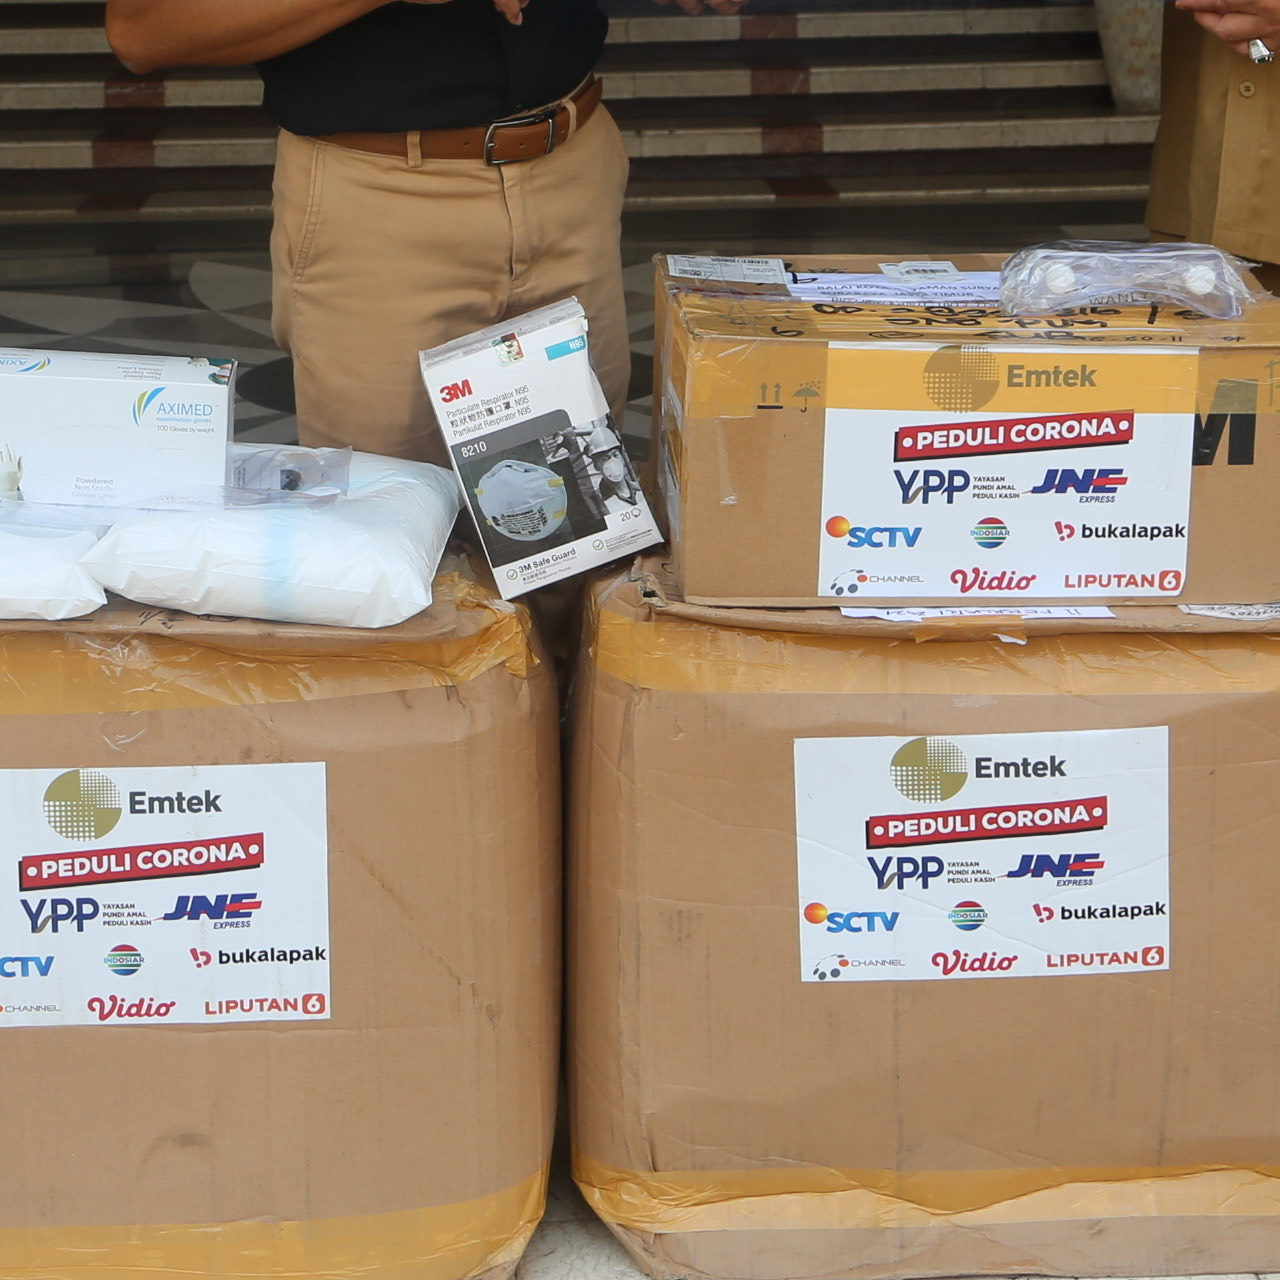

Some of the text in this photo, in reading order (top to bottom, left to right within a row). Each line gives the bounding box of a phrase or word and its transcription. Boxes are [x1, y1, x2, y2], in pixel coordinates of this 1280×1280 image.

[569, 338, 584, 350] N95
[1007, 365, 1097, 389] Emtek
[439, 380, 473, 403] 3M
[446, 385, 529, 419] Particulate Respirator N95
[515, 397, 529, 407] N95
[157, 402, 213, 417] AXIMED
[453, 406, 532, 438] Partikulat Respirator N95
[917, 418, 1116, 450] PEDULI CORONA
[461, 441, 488, 457] 8210
[894, 469, 970, 504] YPP
[1031, 469, 1128, 494] JNE
[620, 511, 631, 521] 20
[847, 527, 923, 548] SCTV
[970, 529, 1010, 537] INDOSIAR
[1082, 522, 1185, 541] bukalapak
[518, 562, 530, 573] 3M
[532, 556, 551, 570] Safe
[552, 548, 576, 565] Guard
[869, 575, 924, 583] CHANNEL
[950, 567, 1036, 593] Vidio
[1064, 574, 1154, 588] LIPUTAN
[975, 756, 1067, 779] Emtek
[129, 790, 223, 815] Emtek
[889, 806, 1090, 838] PEDULI CORONA
[42, 843, 247, 879] PEDULI CORONA
[1006, 853, 1105, 877] JNE
[867, 856, 944, 889] YPP
[1056, 878, 1094, 887] EXPRESS
[20, 898, 99, 933] YPP
[163, 893, 262, 920] JNE
[1061, 902, 1166, 921] bukalapak
[213, 920, 251, 930] EXPRESS
[826, 912, 900, 933] SCTV
[103, 956, 145, 964] INDOSIAR
[218, 946, 326, 966] bukalapak
[851, 959, 906, 967] CHANNEL
[932, 950, 1018, 975] Vidio
[1047, 951, 1138, 968] LIPUTAN
[5, 1004, 61, 1013] CHANNEL
[88, 995, 176, 1021] Vidio
[205, 998, 298, 1015] LIPUTAN
